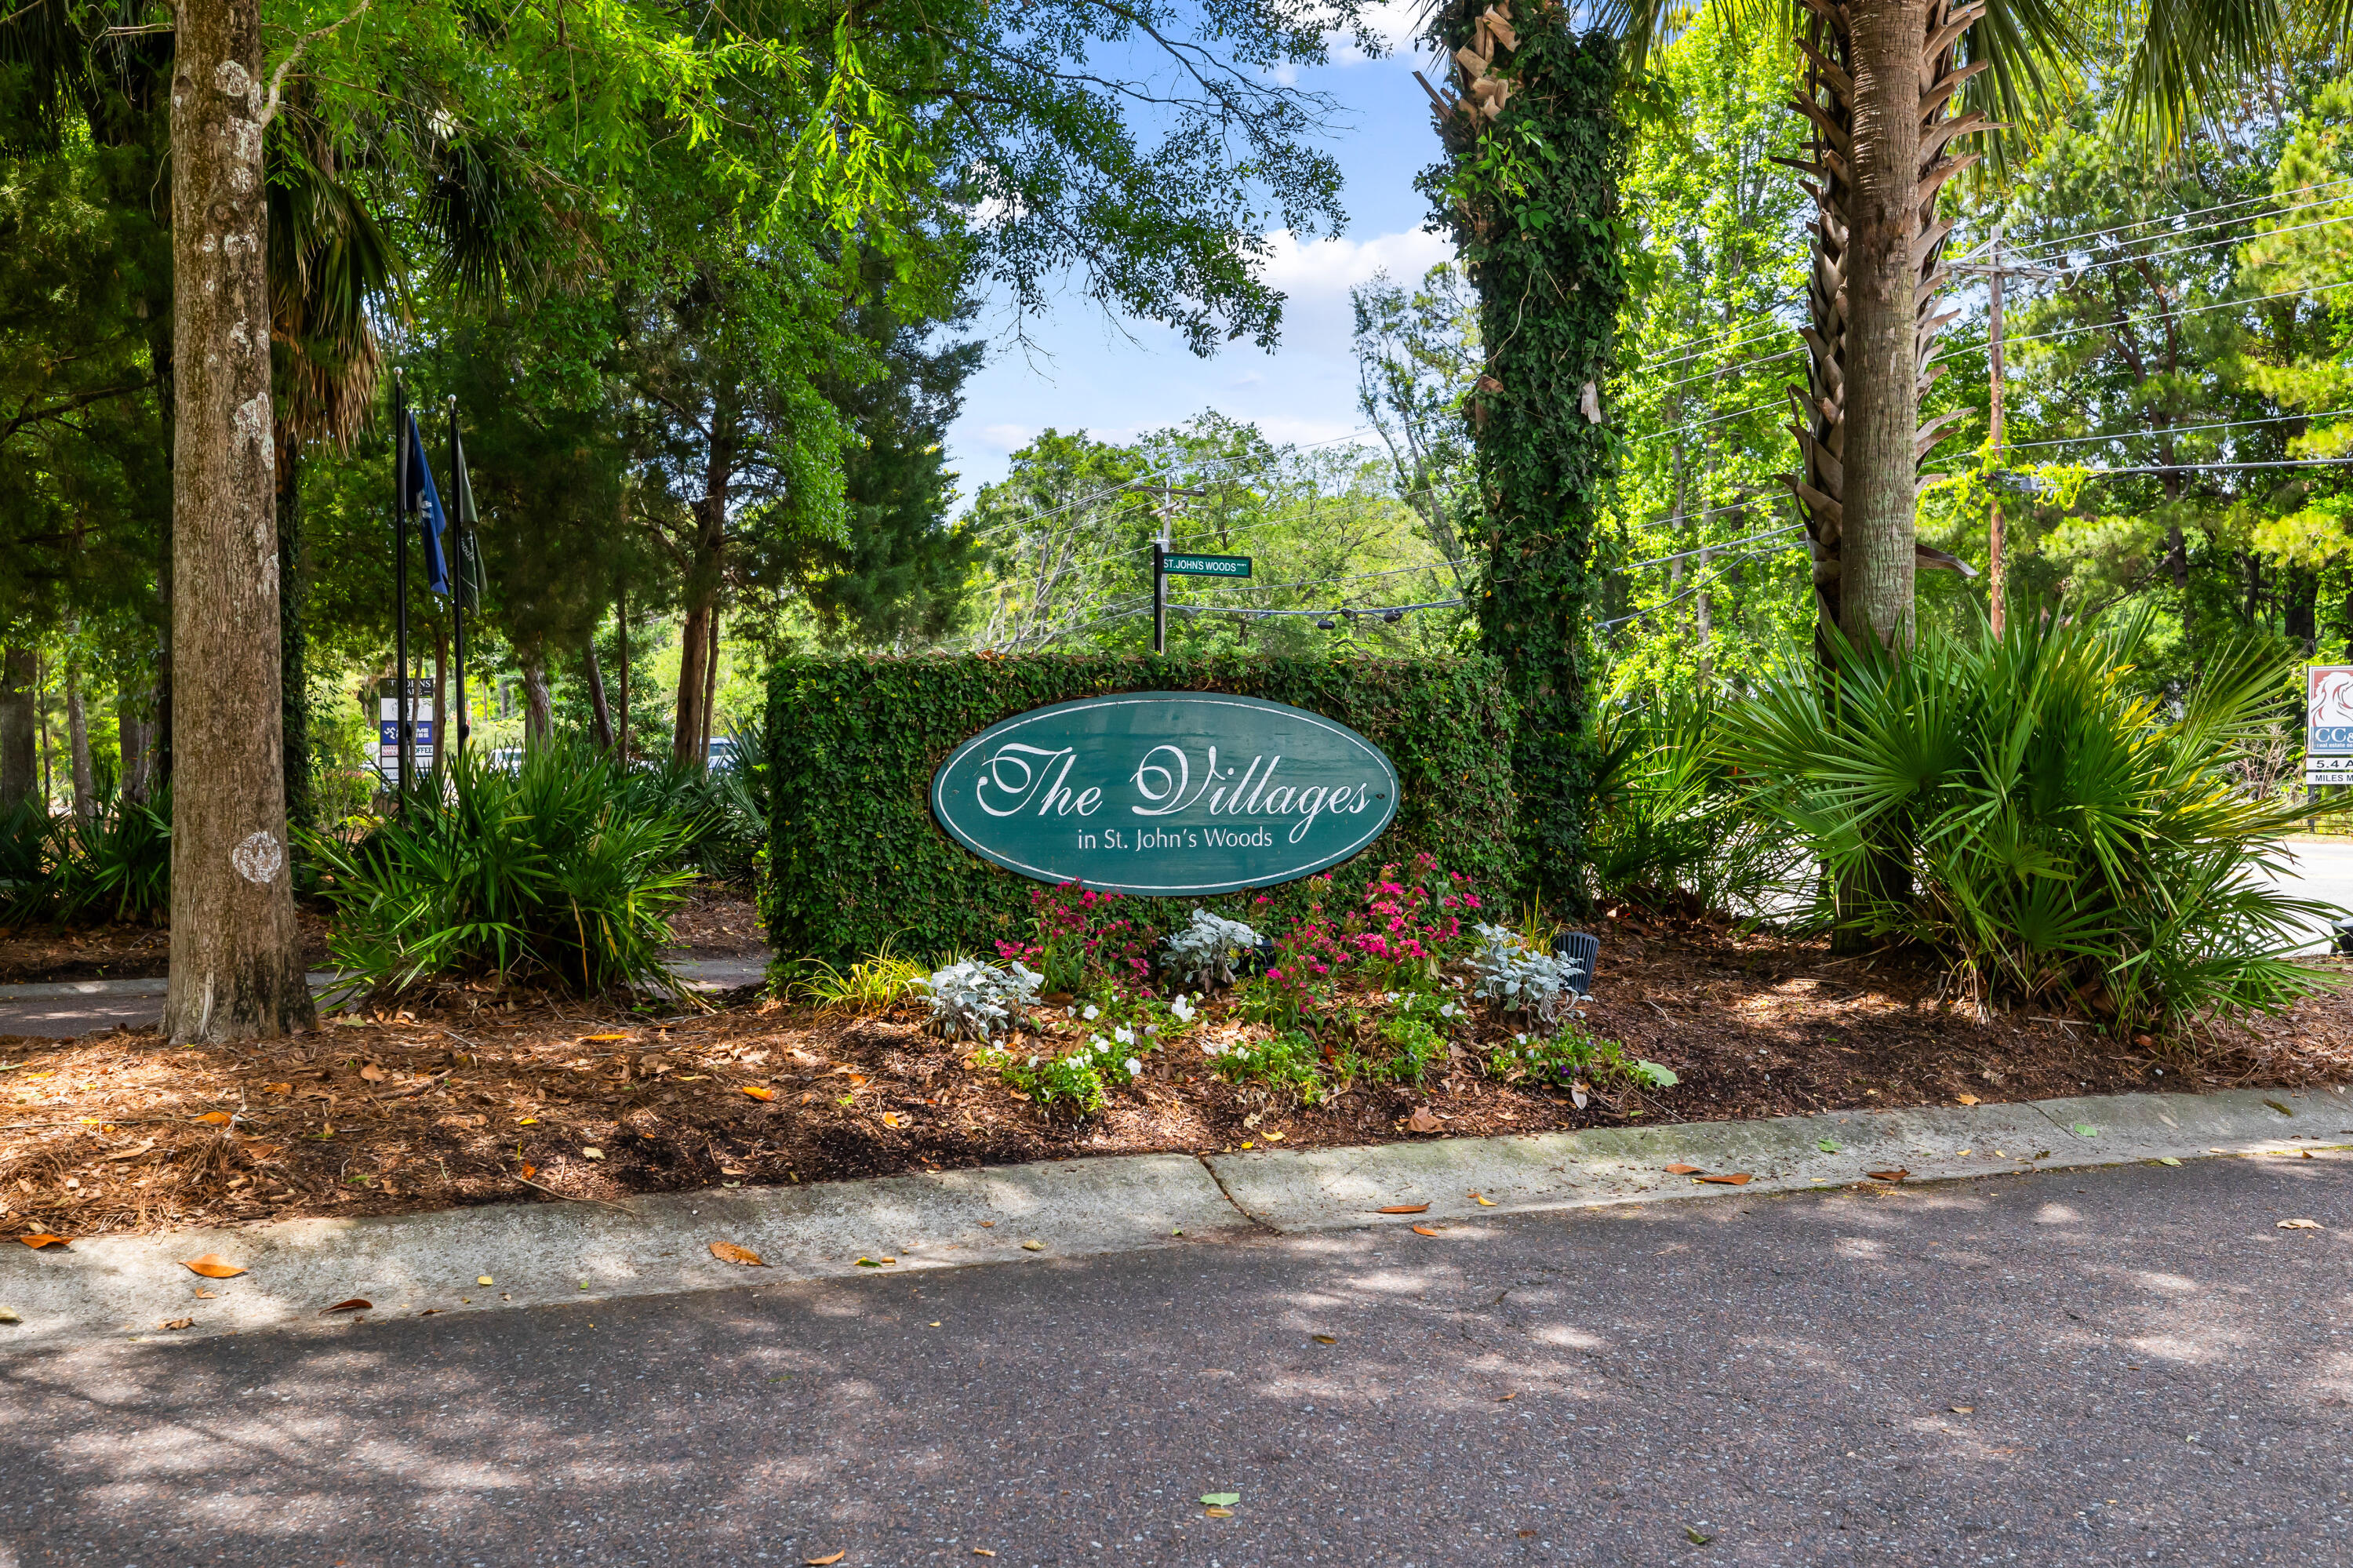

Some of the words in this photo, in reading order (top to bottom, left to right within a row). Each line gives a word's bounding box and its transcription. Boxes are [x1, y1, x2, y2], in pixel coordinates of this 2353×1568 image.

[1206, 562, 1236, 572] WOODS
[2316, 759, 2340, 768] 5.4
[976, 742, 1103, 817] The
[1129, 744, 1370, 844] Villages
[1078, 828, 1096, 849] in
[1104, 828, 1129, 849] St.
[1136, 827, 1197, 850] John's
[1203, 826, 1272, 848] Woods
